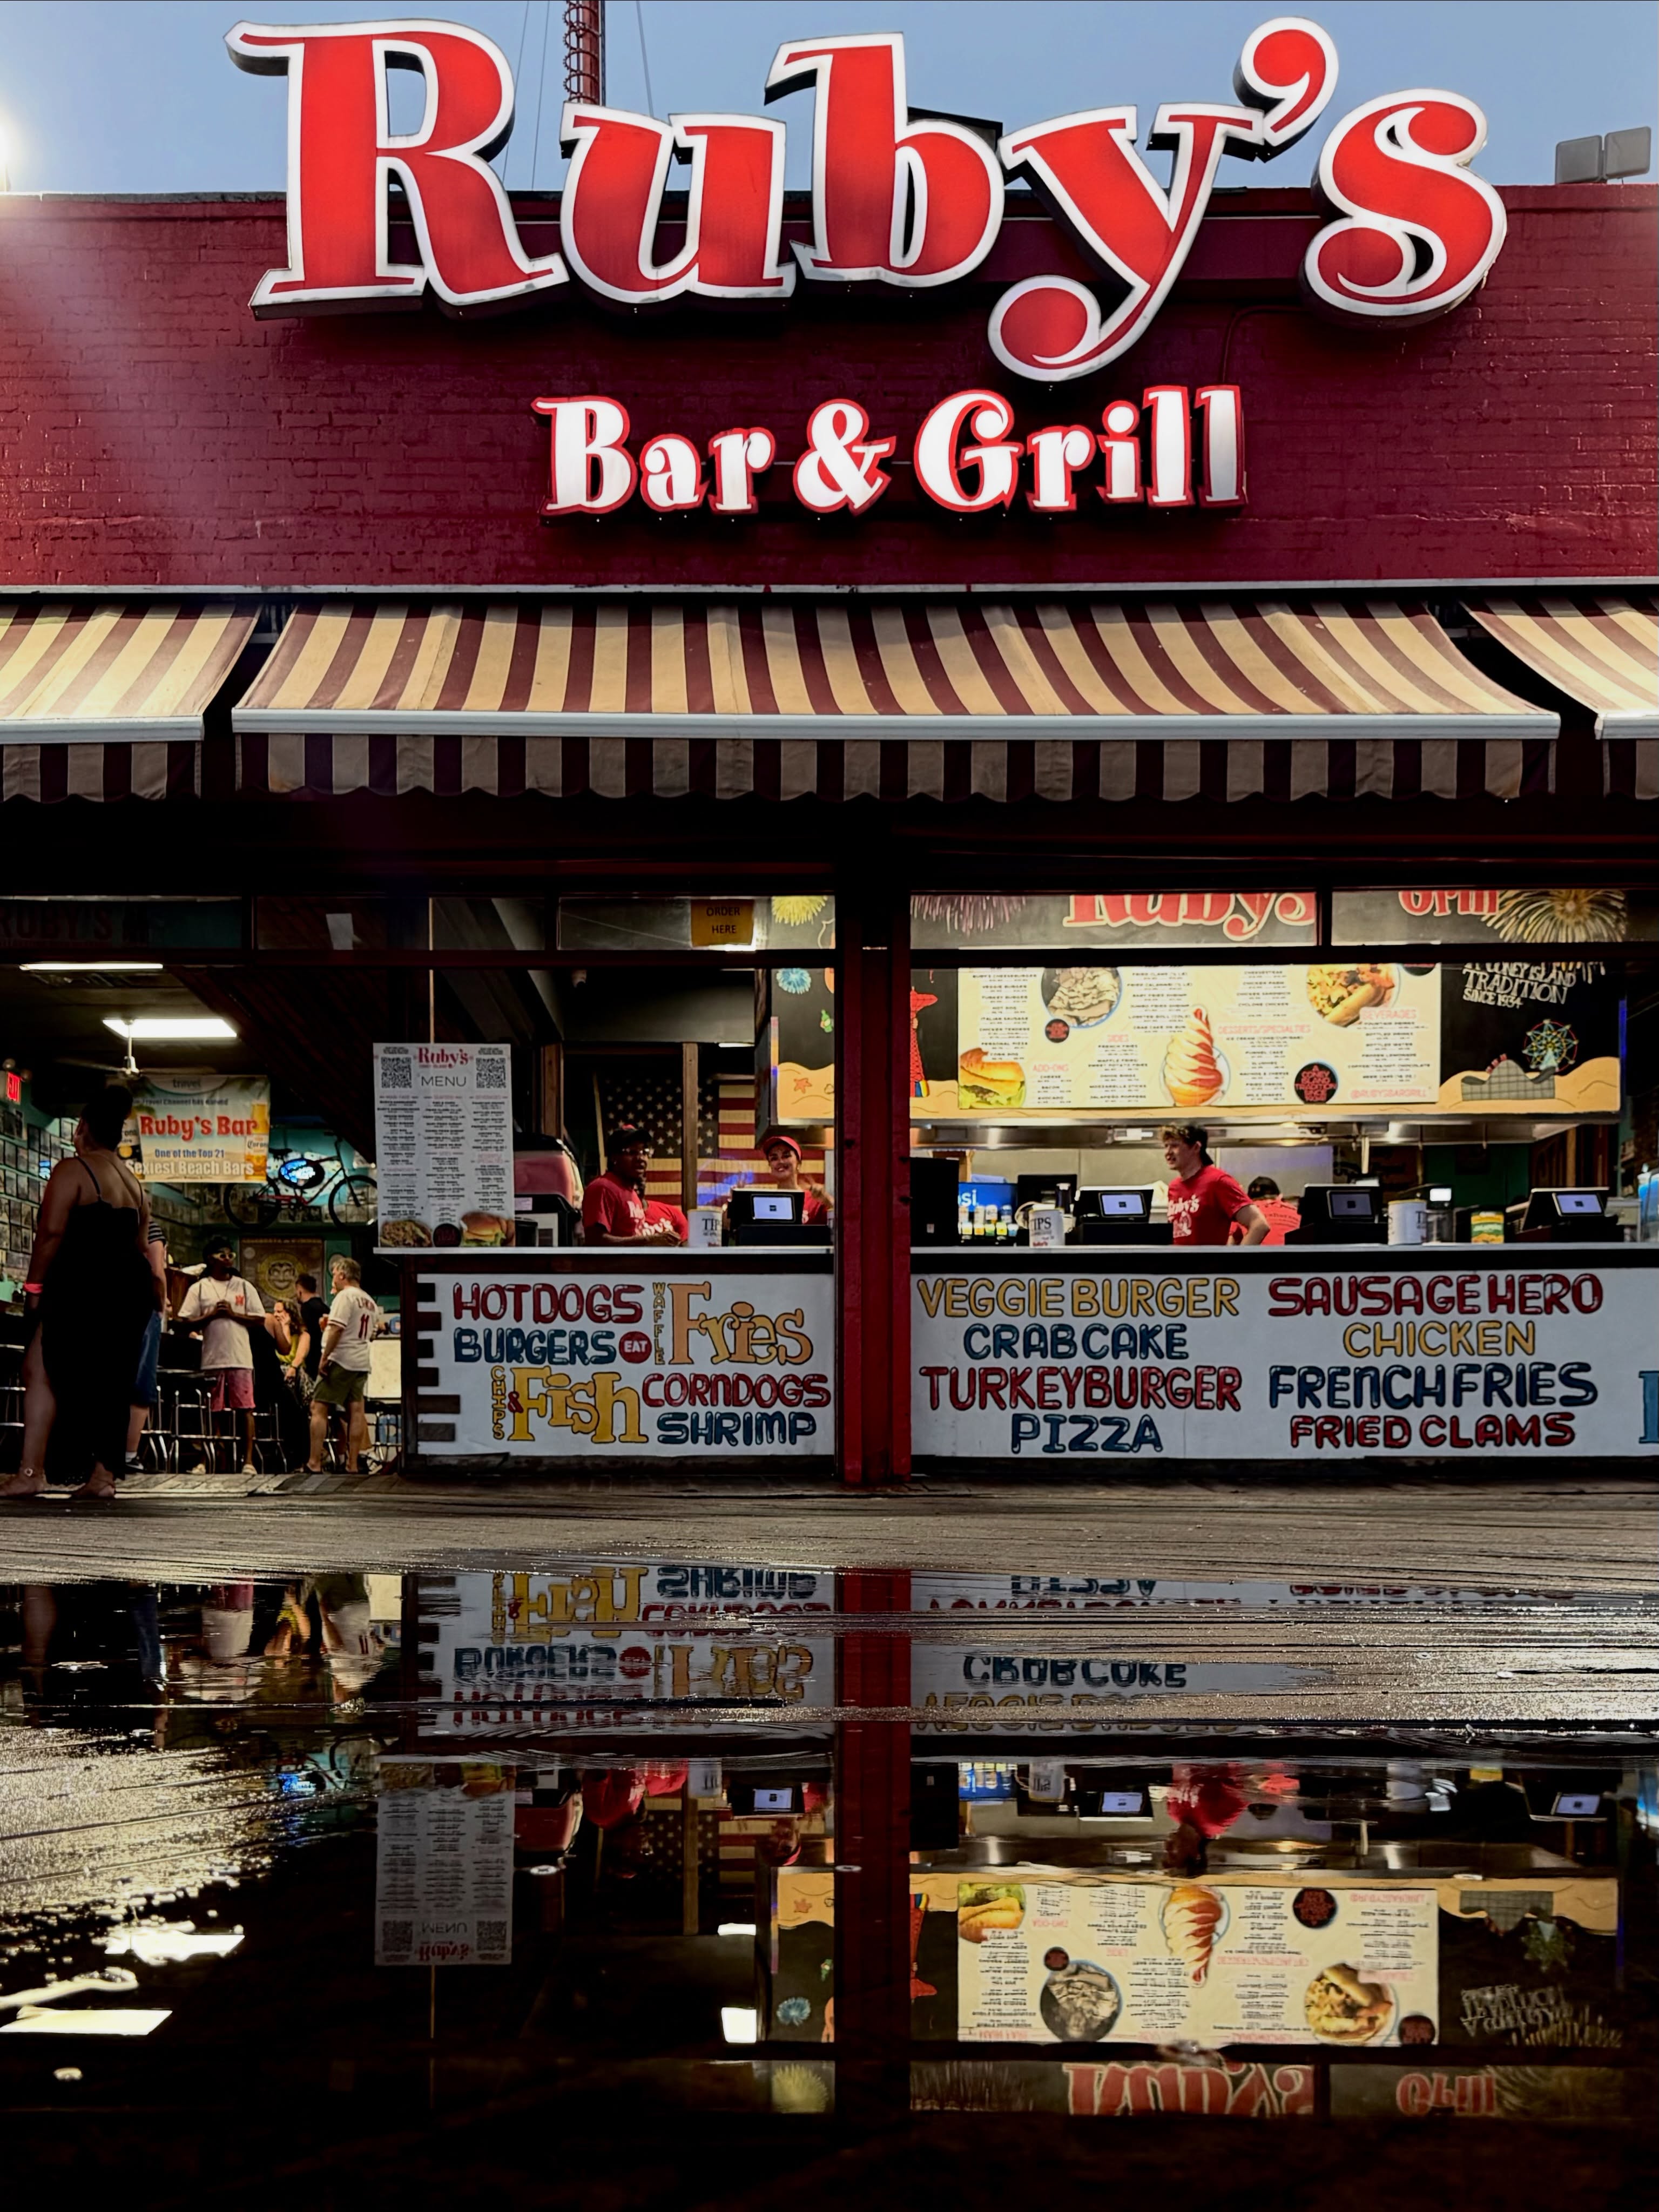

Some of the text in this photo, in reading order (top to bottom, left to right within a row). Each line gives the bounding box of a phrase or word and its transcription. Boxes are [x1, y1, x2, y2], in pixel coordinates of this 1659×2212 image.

[221, 15, 1510, 382] Ruby's
[531, 383, 1250, 517] Bar & Grill
[706, 907, 740, 916] ORDER
[712, 925, 737, 934] HERE
[1462, 968, 1568, 1005] TRADITION
[1462, 988, 1523, 1010] SINCE 1934
[419, 1046, 469, 1069] Ruby's
[421, 1076, 467, 1087] MENU
[140, 1115, 258, 1141] Ruby's Bar
[125, 1161, 254, 1176] Sexiest Beach Bars
[155, 1149, 224, 1158] One of the Top 21
[918, 1277, 1240, 1318] VEGGIE BURGER
[1268, 1273, 1604, 1317] SAUSAGE HERO
[652, 1282, 666, 1366] WAFFLE
[667, 1281, 814, 1365] Fries
[963, 1323, 1189, 1360] CRAB CAKE
[1343, 1320, 1535, 1358] CHICKEN
[454, 1327, 617, 1366] BURGERS
[624, 1339, 648, 1354] EAT
[491, 1365, 507, 1440] CHIPS
[508, 1391, 524, 1414] &
[1269, 1364, 1446, 1410] FRENCH
[1452, 1361, 1599, 1408] FRIES
[508, 1365, 649, 1445] Fish
[657, 1411, 818, 1447] SHRIMP
[1011, 1413, 1164, 1454] PIZZA
[1290, 1412, 1576, 1449] FRIED CLAMS
